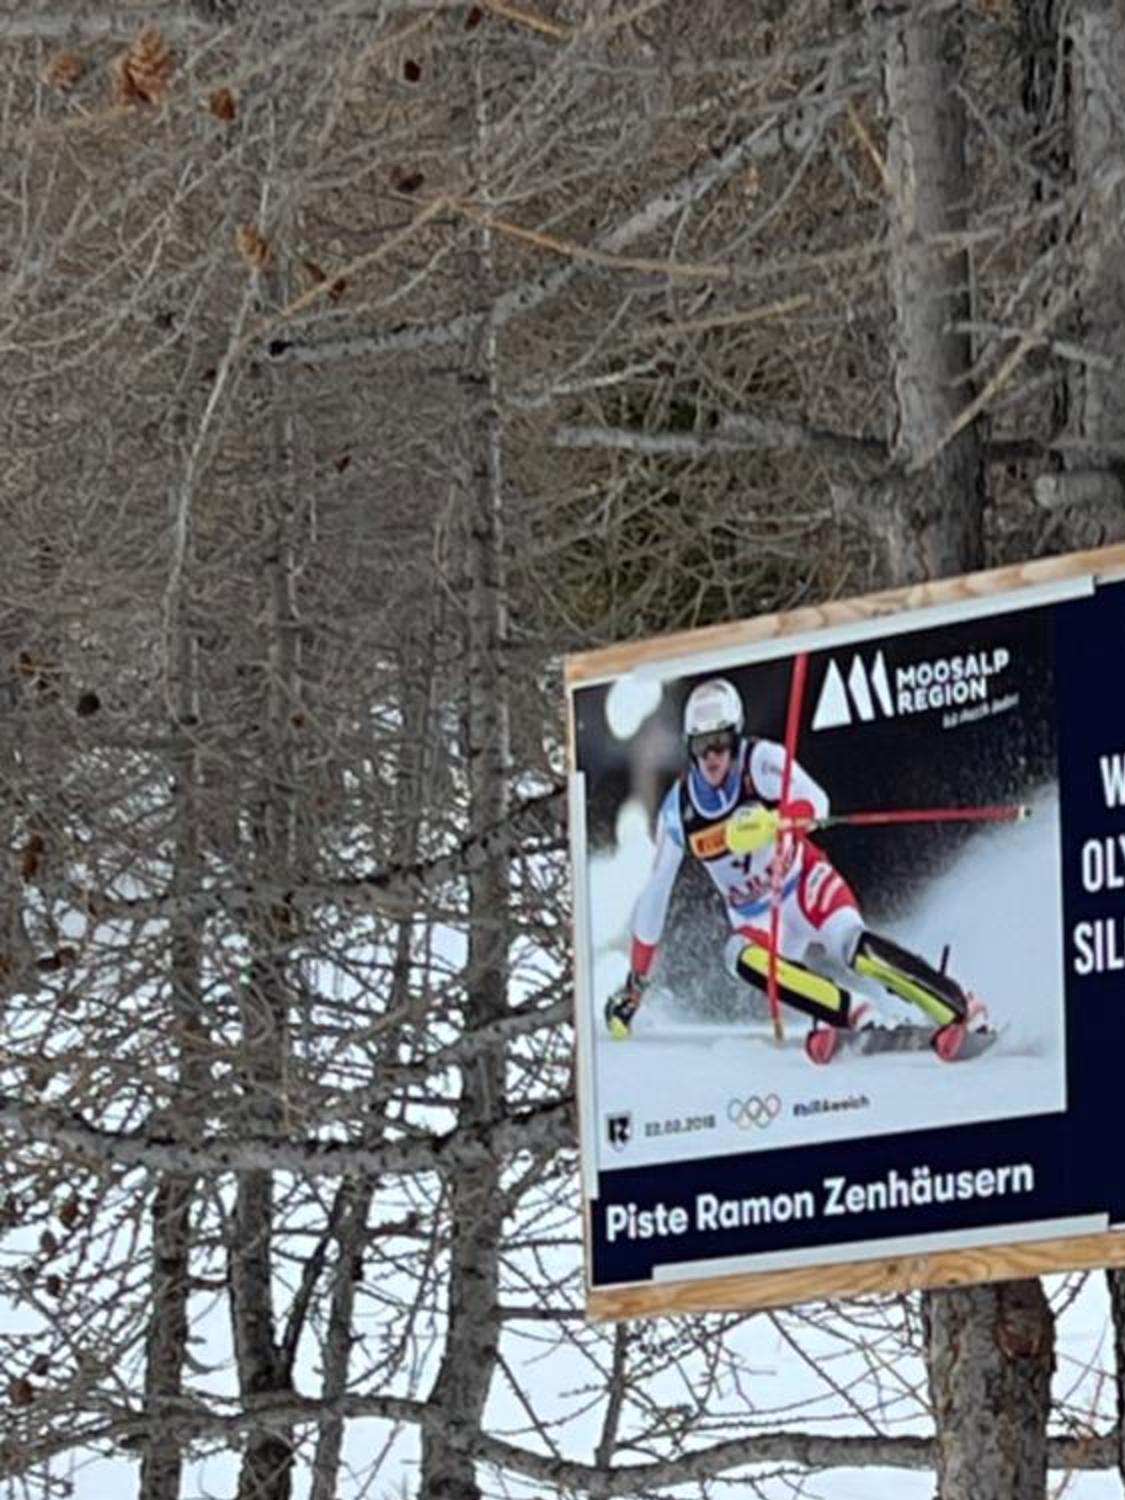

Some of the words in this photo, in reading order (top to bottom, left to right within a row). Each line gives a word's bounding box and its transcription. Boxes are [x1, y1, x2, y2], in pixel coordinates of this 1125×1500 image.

[895, 648, 1009, 690] MOOSALP
[897, 677, 987, 715] REGION
[606, 1202, 688, 1242] Piste
[696, 1190, 814, 1231] Ramon
[823, 1163, 1035, 1216] Zenhäusern
